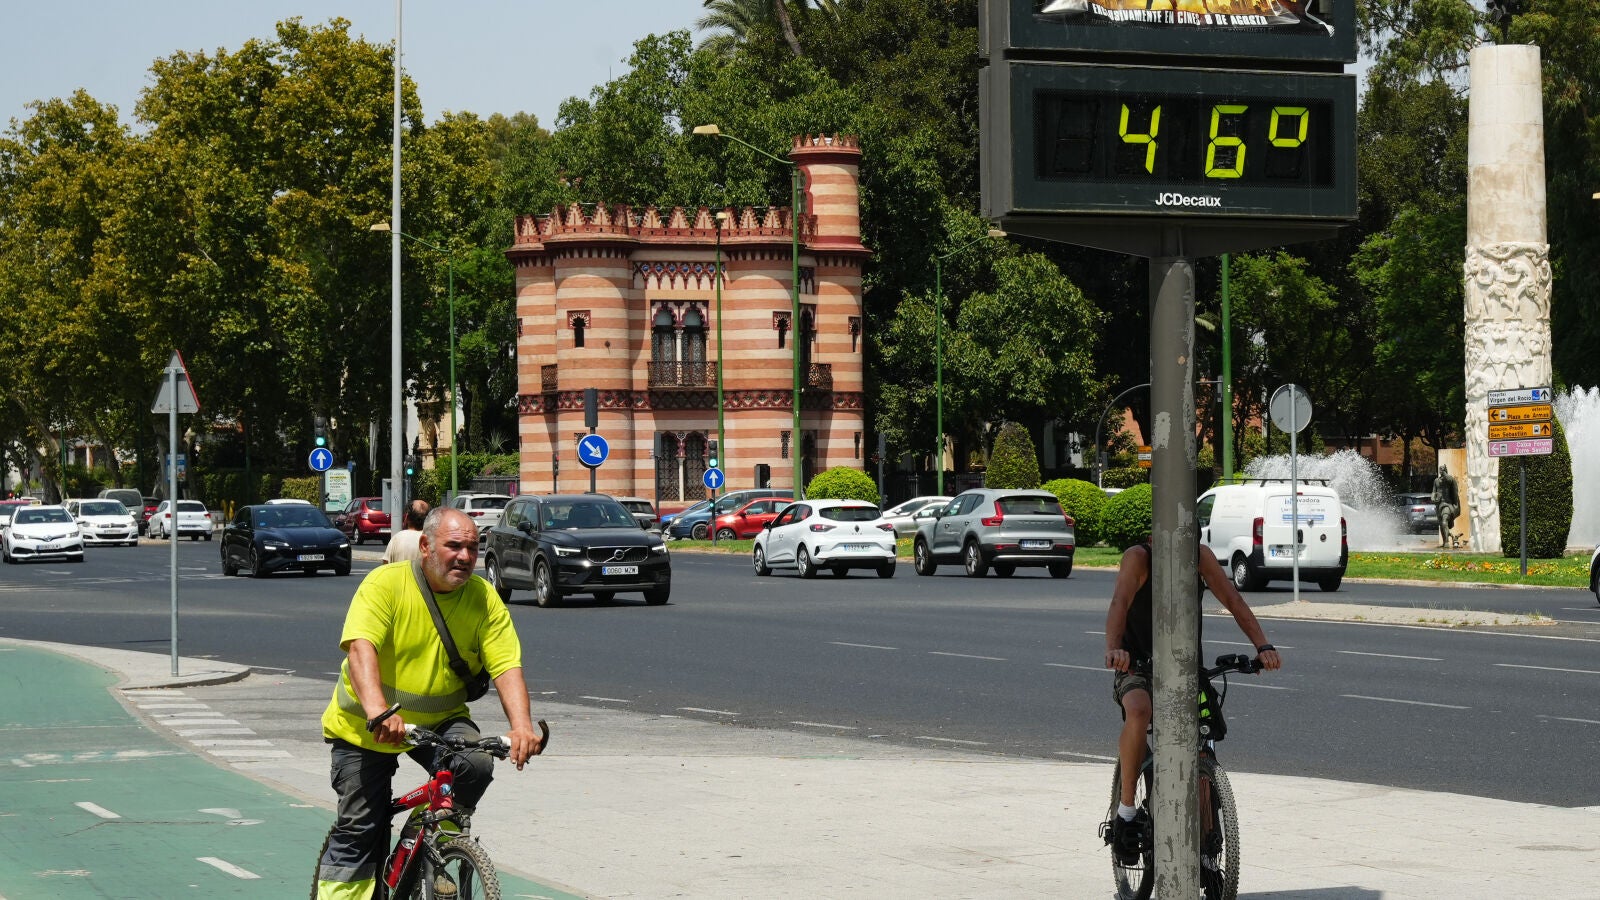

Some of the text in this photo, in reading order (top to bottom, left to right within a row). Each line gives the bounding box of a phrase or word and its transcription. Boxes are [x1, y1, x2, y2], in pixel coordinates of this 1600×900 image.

[1165, 10, 1175, 23] EN
[1177, 11, 1201, 25] CINES
[1215, 14, 1229, 25] DE
[1230, 15, 1268, 25] AGOSTO
[1155, 192, 1222, 207] JCDecaux
